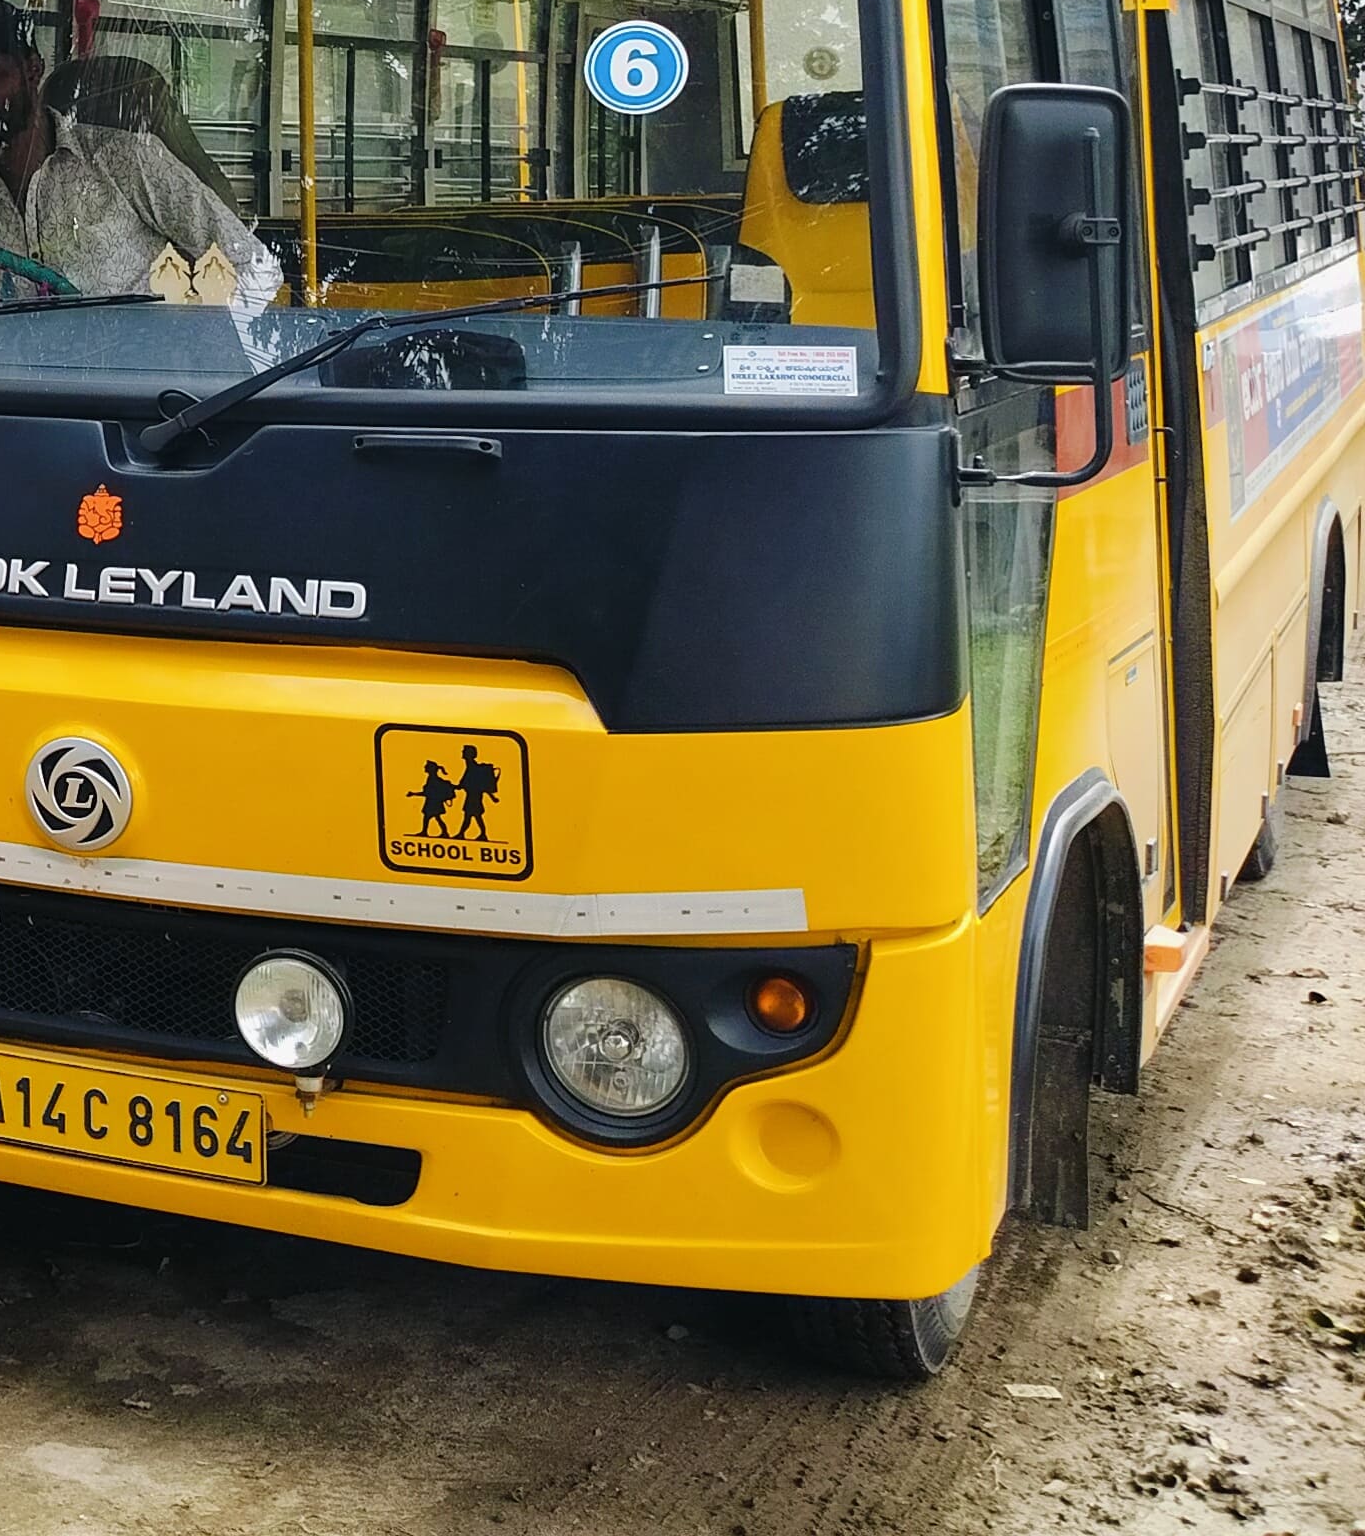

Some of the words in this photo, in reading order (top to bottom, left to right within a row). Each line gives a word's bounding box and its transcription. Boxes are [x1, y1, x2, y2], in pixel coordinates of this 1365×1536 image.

[608, 37, 661, 98] 6
[759, 373, 796, 381] LAKSHMI
[797, 374, 851, 382] COMMERCIAL
[64, 562, 367, 619] LEYLAND
[60, 777, 94, 809] L
[391, 840, 473, 862] SCHOOL
[480, 847, 521, 865] BUS
[128, 1095, 253, 1164] 8164
